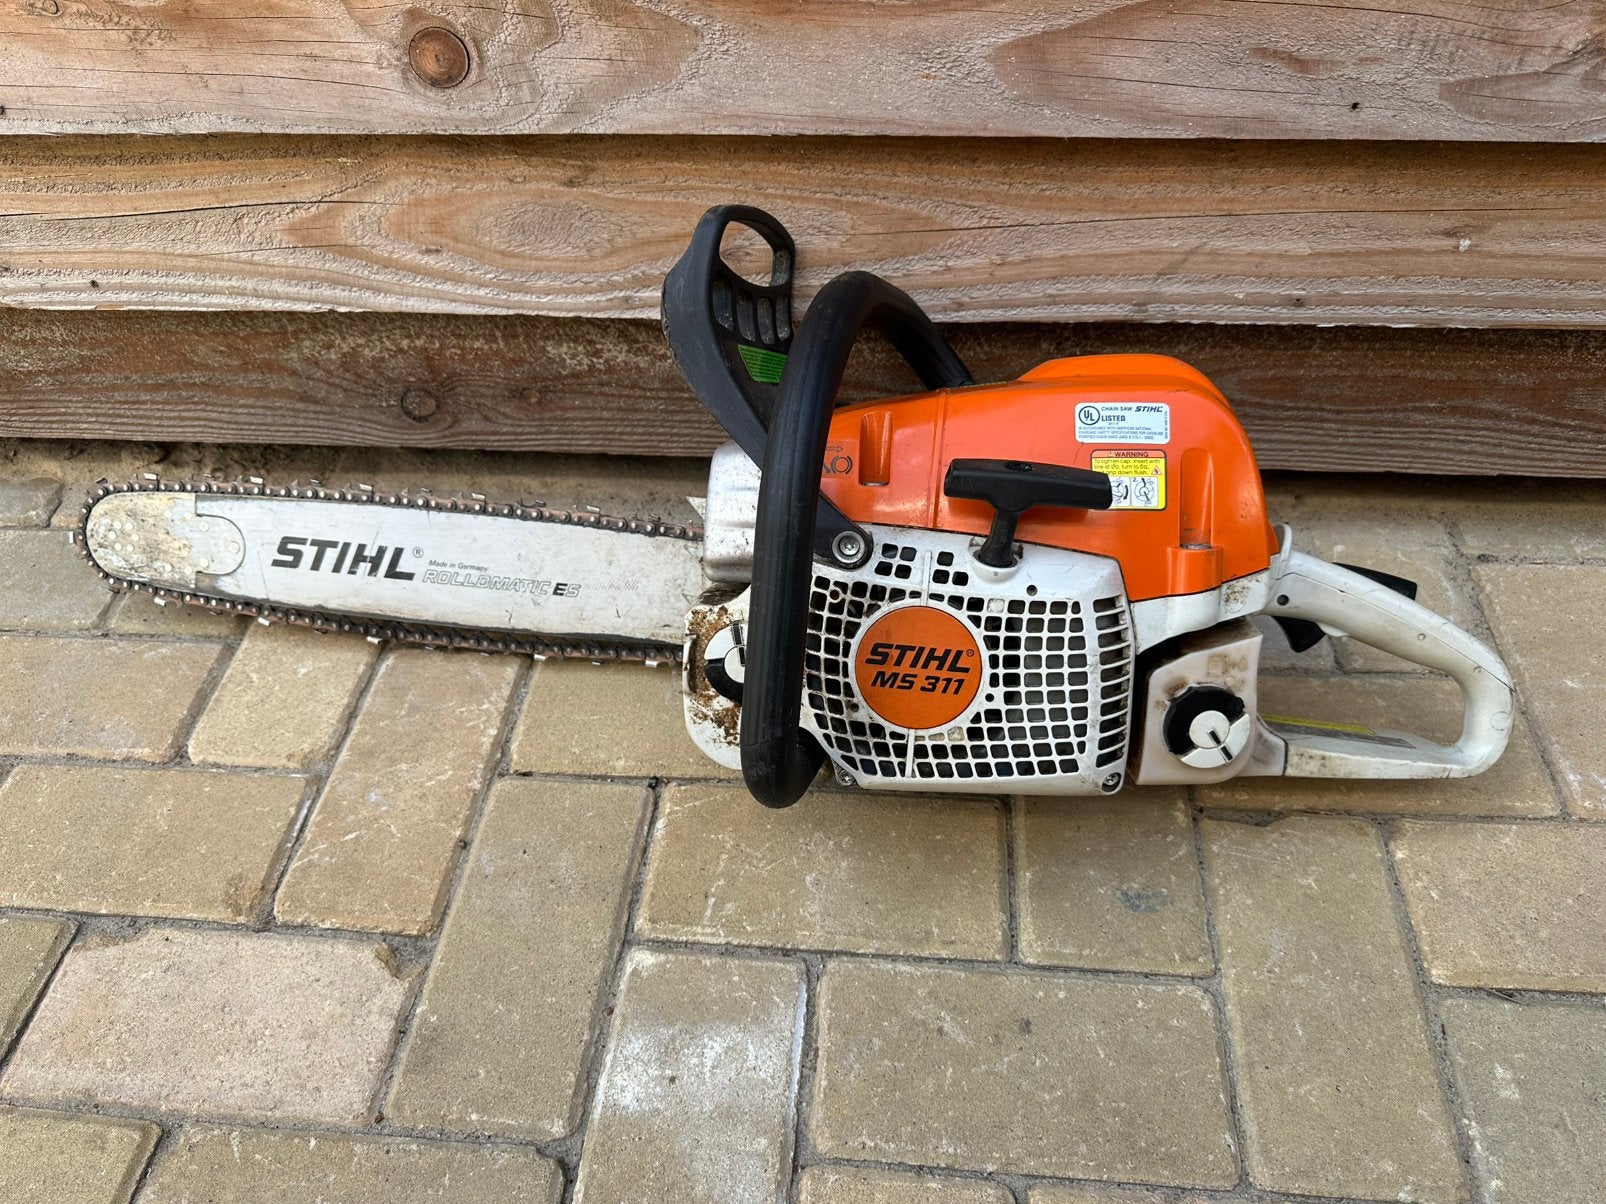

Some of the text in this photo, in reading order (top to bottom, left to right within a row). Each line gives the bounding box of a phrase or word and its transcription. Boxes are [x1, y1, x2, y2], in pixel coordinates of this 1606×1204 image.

[428, 559, 447, 568] Made
[458, 562, 488, 572] Germany
[422, 569, 581, 598] ROLLOMATIC ES
[871, 670, 965, 695] MS 311
